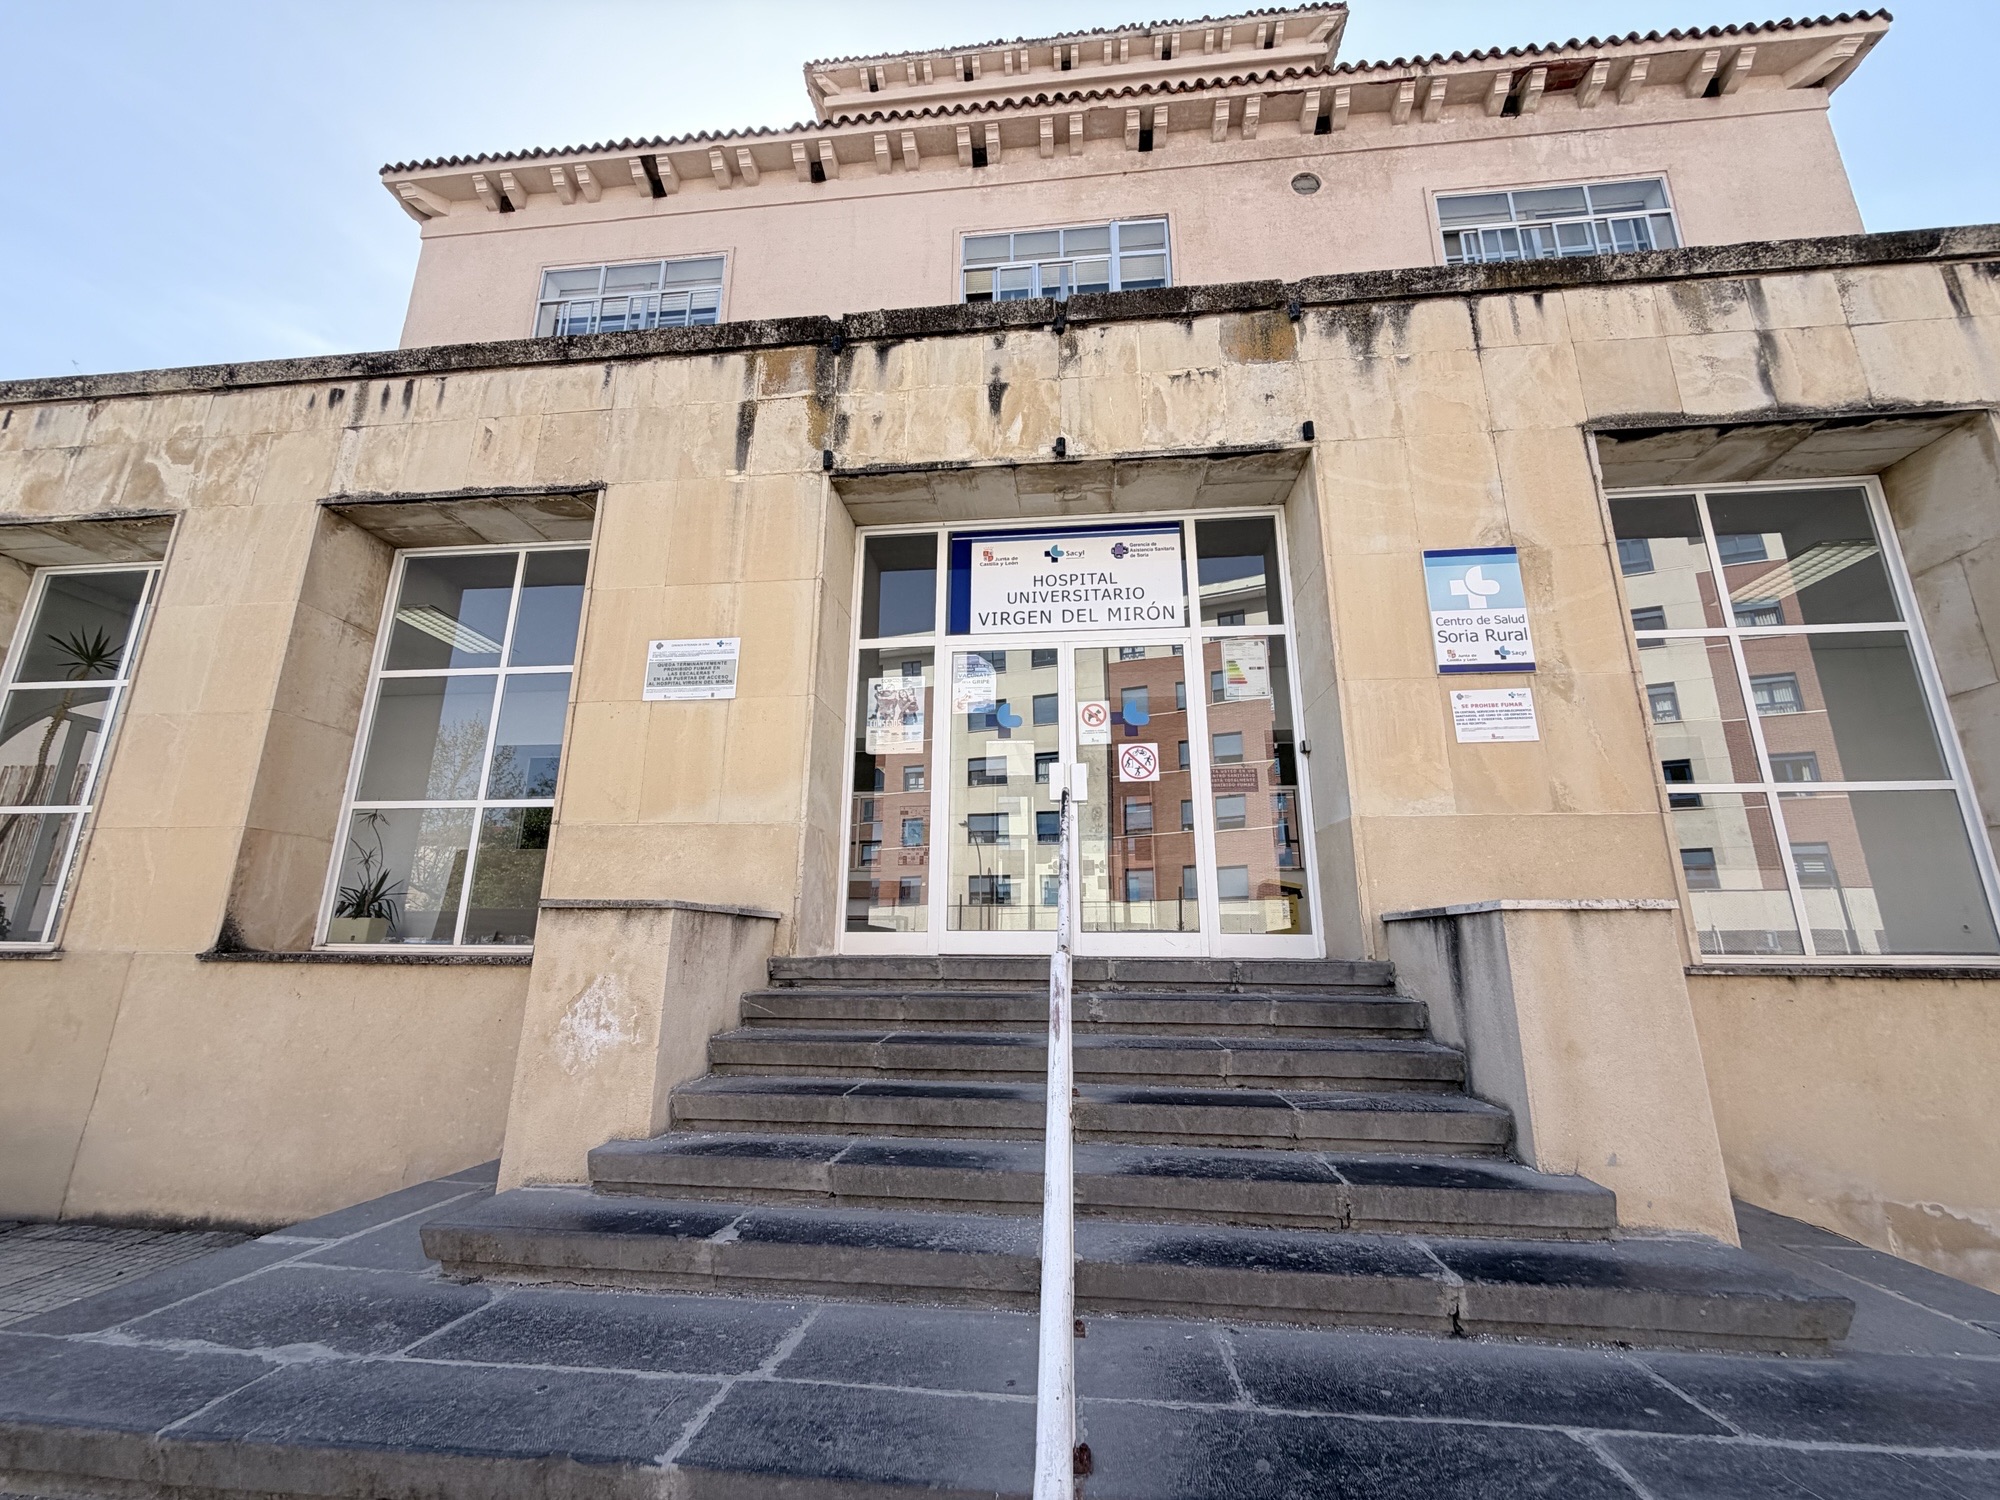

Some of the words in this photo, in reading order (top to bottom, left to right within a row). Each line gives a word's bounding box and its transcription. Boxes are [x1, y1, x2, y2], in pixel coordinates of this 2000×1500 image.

[1033, 572, 1118, 588] HOSPITAL
[1007, 586, 1145, 605] UNIVERSITARIO
[978, 609, 1052, 626] VIRGEN
[1062, 608, 1098, 624] DEL
[1107, 601, 1175, 622] MIRÓN
[1435, 616, 1473, 626] Centro
[1477, 615, 1491, 625] de
[1494, 613, 1525, 625] Salud
[1437, 629, 1479, 643] Soria
[1485, 627, 1528, 642] Rural
